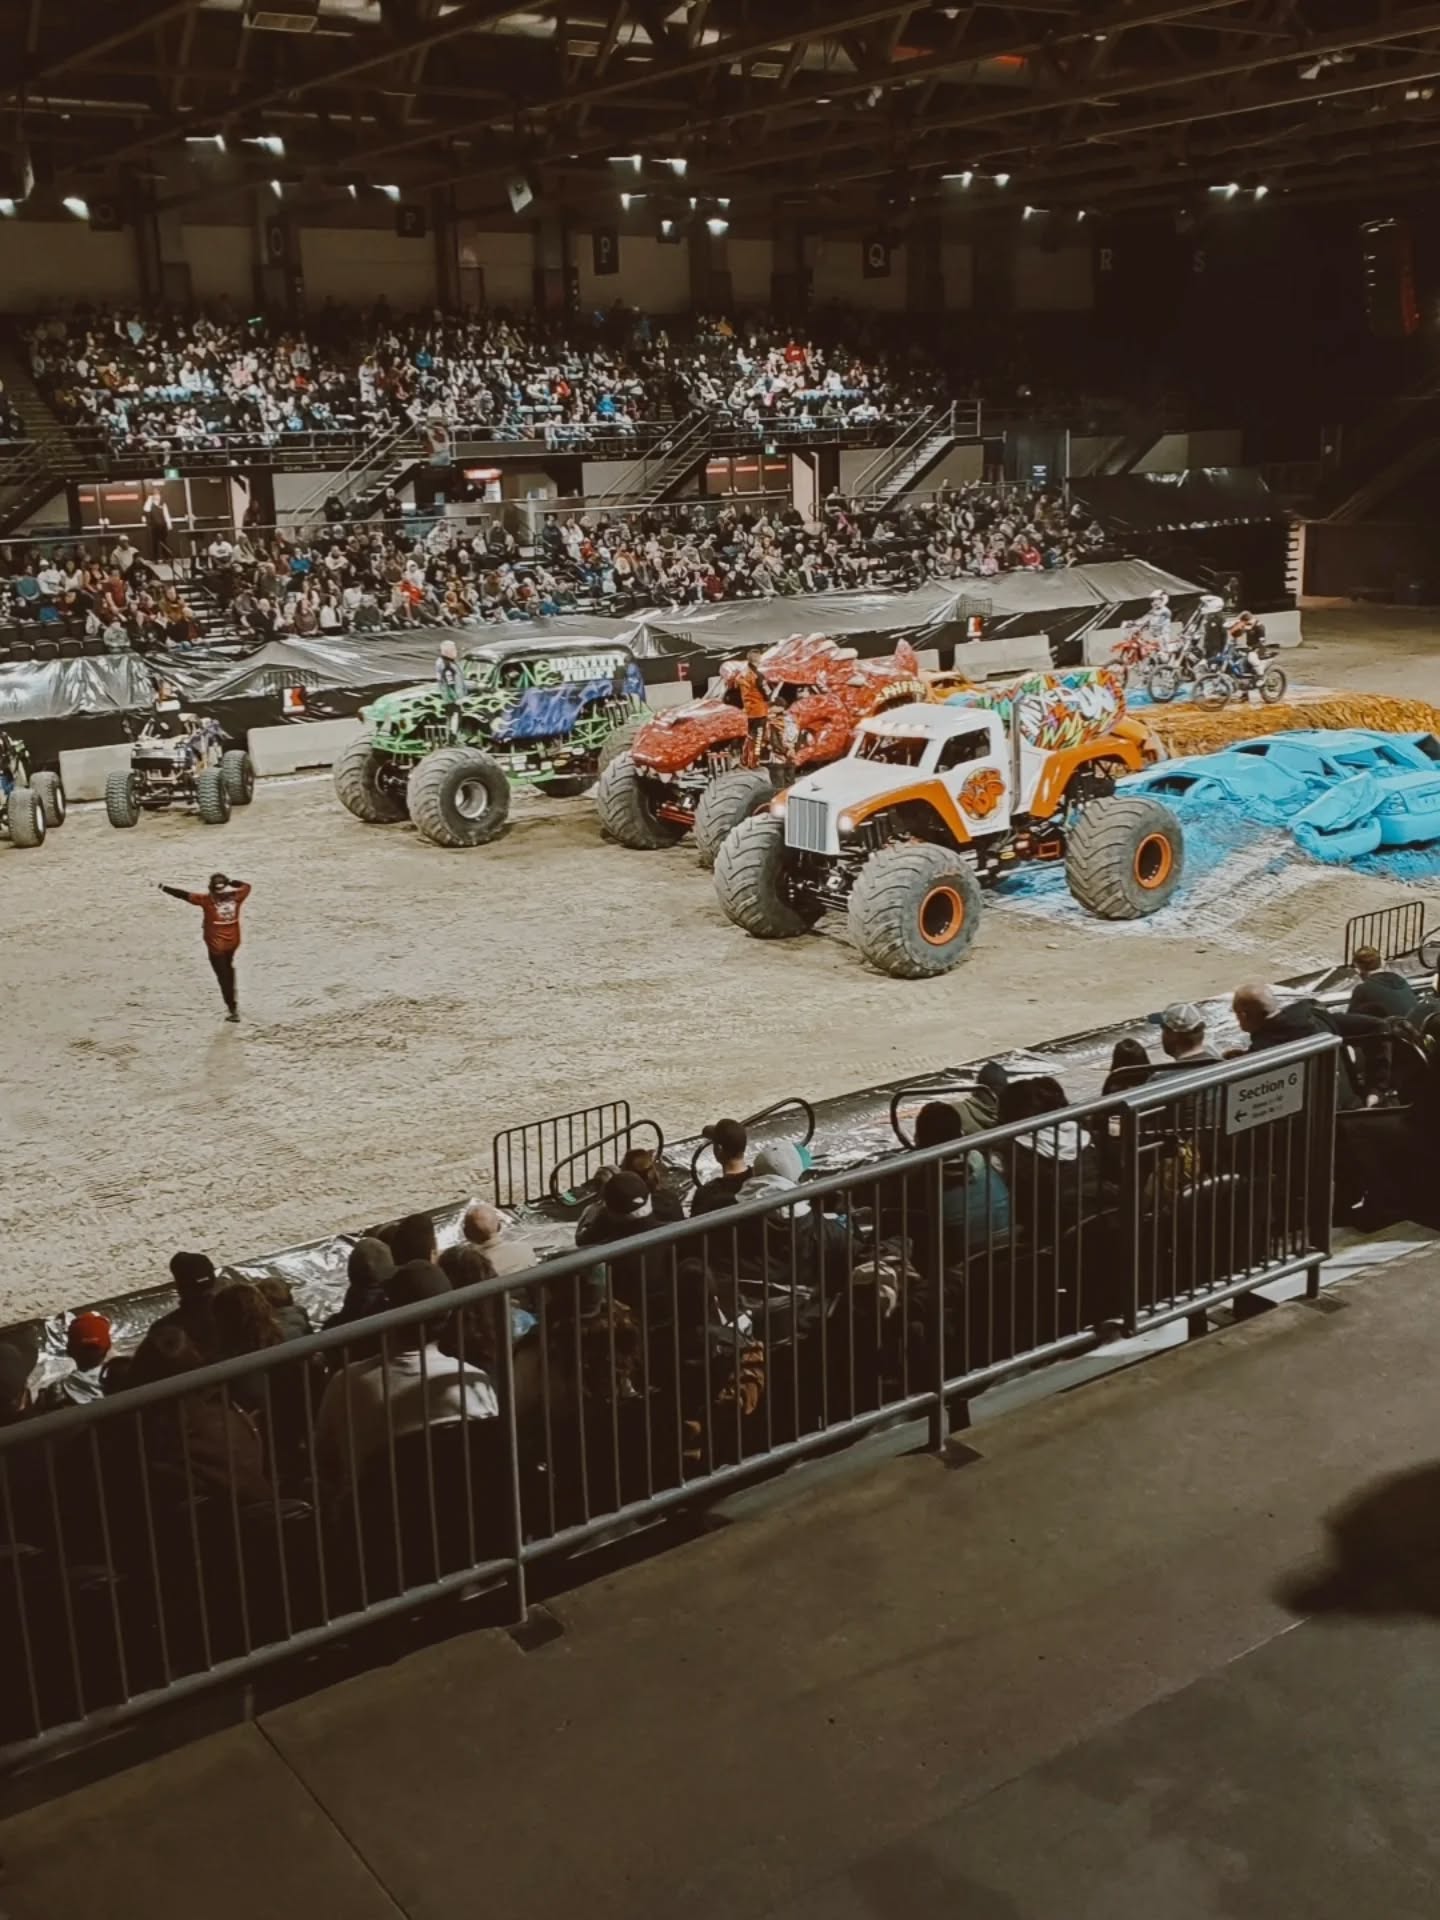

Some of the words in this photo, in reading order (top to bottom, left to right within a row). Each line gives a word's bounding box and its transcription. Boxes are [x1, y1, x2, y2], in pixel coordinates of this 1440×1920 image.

[600, 236, 611, 263] P
[868, 243, 885, 268] Q
[1100, 248, 1113, 271] R
[1192, 249, 1206, 272] S
[548, 655, 625, 672] IDENTITY
[561, 666, 616, 681] THEFT
[1239, 1079, 1285, 1102] Section
[1287, 1072, 1297, 1085] G
